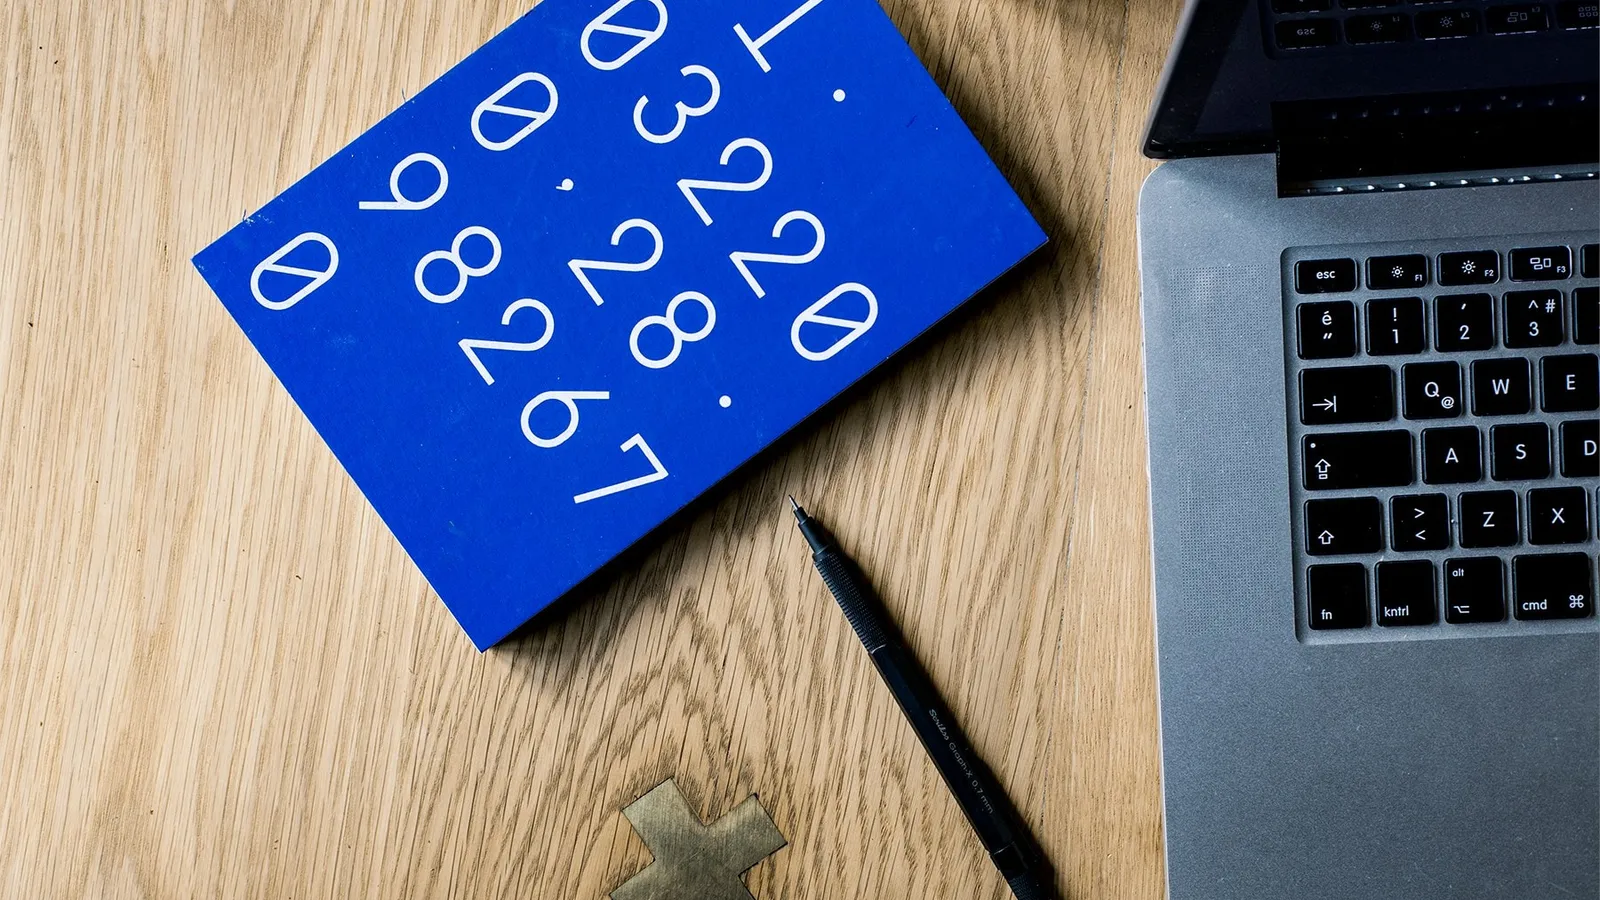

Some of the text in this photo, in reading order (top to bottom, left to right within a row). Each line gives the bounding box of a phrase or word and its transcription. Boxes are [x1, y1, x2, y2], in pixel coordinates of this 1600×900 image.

[250, 231, 339, 311] 0
[1315, 269, 1337, 280] esc
[1544, 298, 1557, 314] #
[1321, 309, 1333, 326] é
[1391, 328, 1399, 344] 1
[1459, 324, 1471, 340] 2
[1528, 321, 1540, 337] 3
[1424, 381, 1440, 398] Q
[1491, 378, 1510, 395] W
[1565, 374, 1577, 391] E
[1440, 395, 1455, 410] @
[1444, 447, 1460, 464] A
[1515, 443, 1527, 460] S
[1583, 439, 1598, 456] D
[1482, 511, 1496, 528] Z
[1551, 507, 1566, 524] X
[1451, 566, 1465, 578] alt
[1383, 603, 1410, 618] kntrl
[1522, 598, 1549, 612] cmd
[1320, 608, 1334, 621] fn
